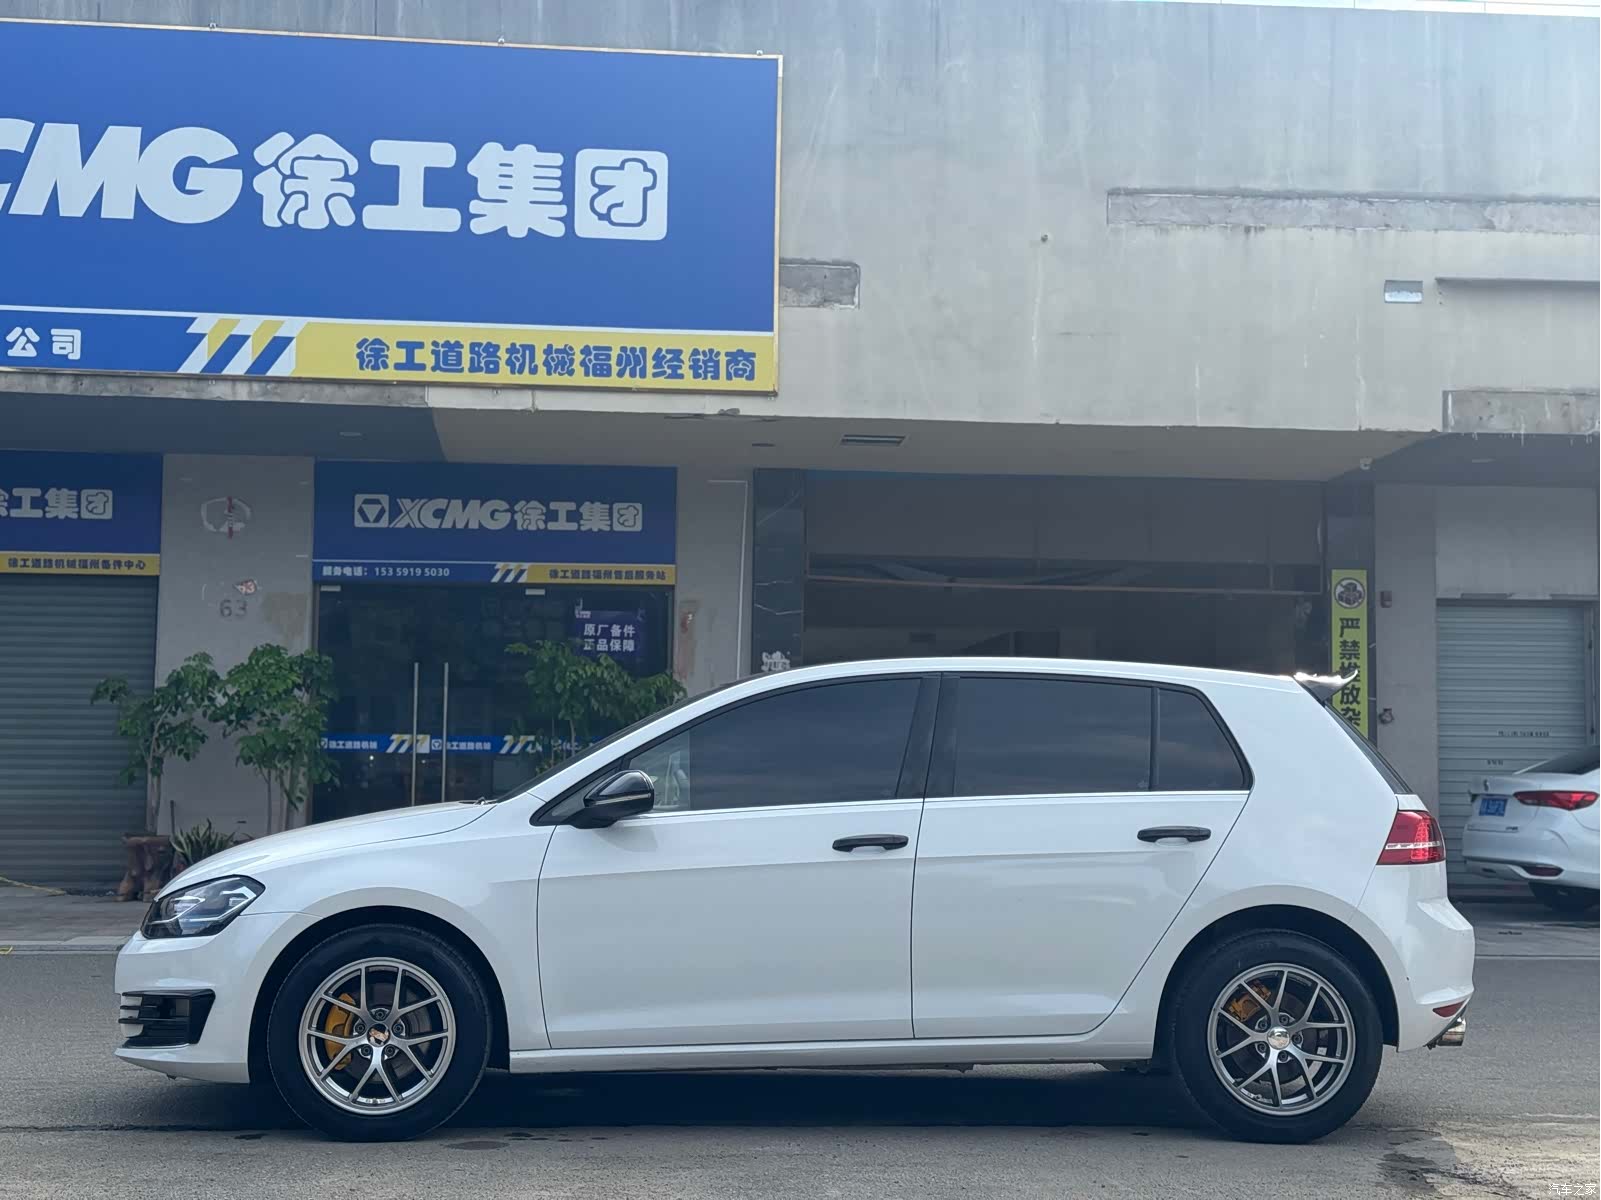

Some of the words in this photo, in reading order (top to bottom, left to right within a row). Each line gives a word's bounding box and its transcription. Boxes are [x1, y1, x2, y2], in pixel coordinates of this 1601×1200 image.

[252, 131, 669, 241] 徐工集团
[6, 326, 82, 360] 公司
[355, 337, 757, 381] 徐工道路机械福州经销商
[0, 487, 113, 519] 工集团
[390, 498, 511, 530] XCMG
[514, 500, 643, 532] 徐工集团
[374, 567, 394, 577] 153
[396, 567, 422, 577] 5919
[424, 568, 450, 577] 5030
[219, 599, 248, 617] 63
[583, 624, 636, 638] 原厂备件
[583, 639, 636, 653] 正品保障
